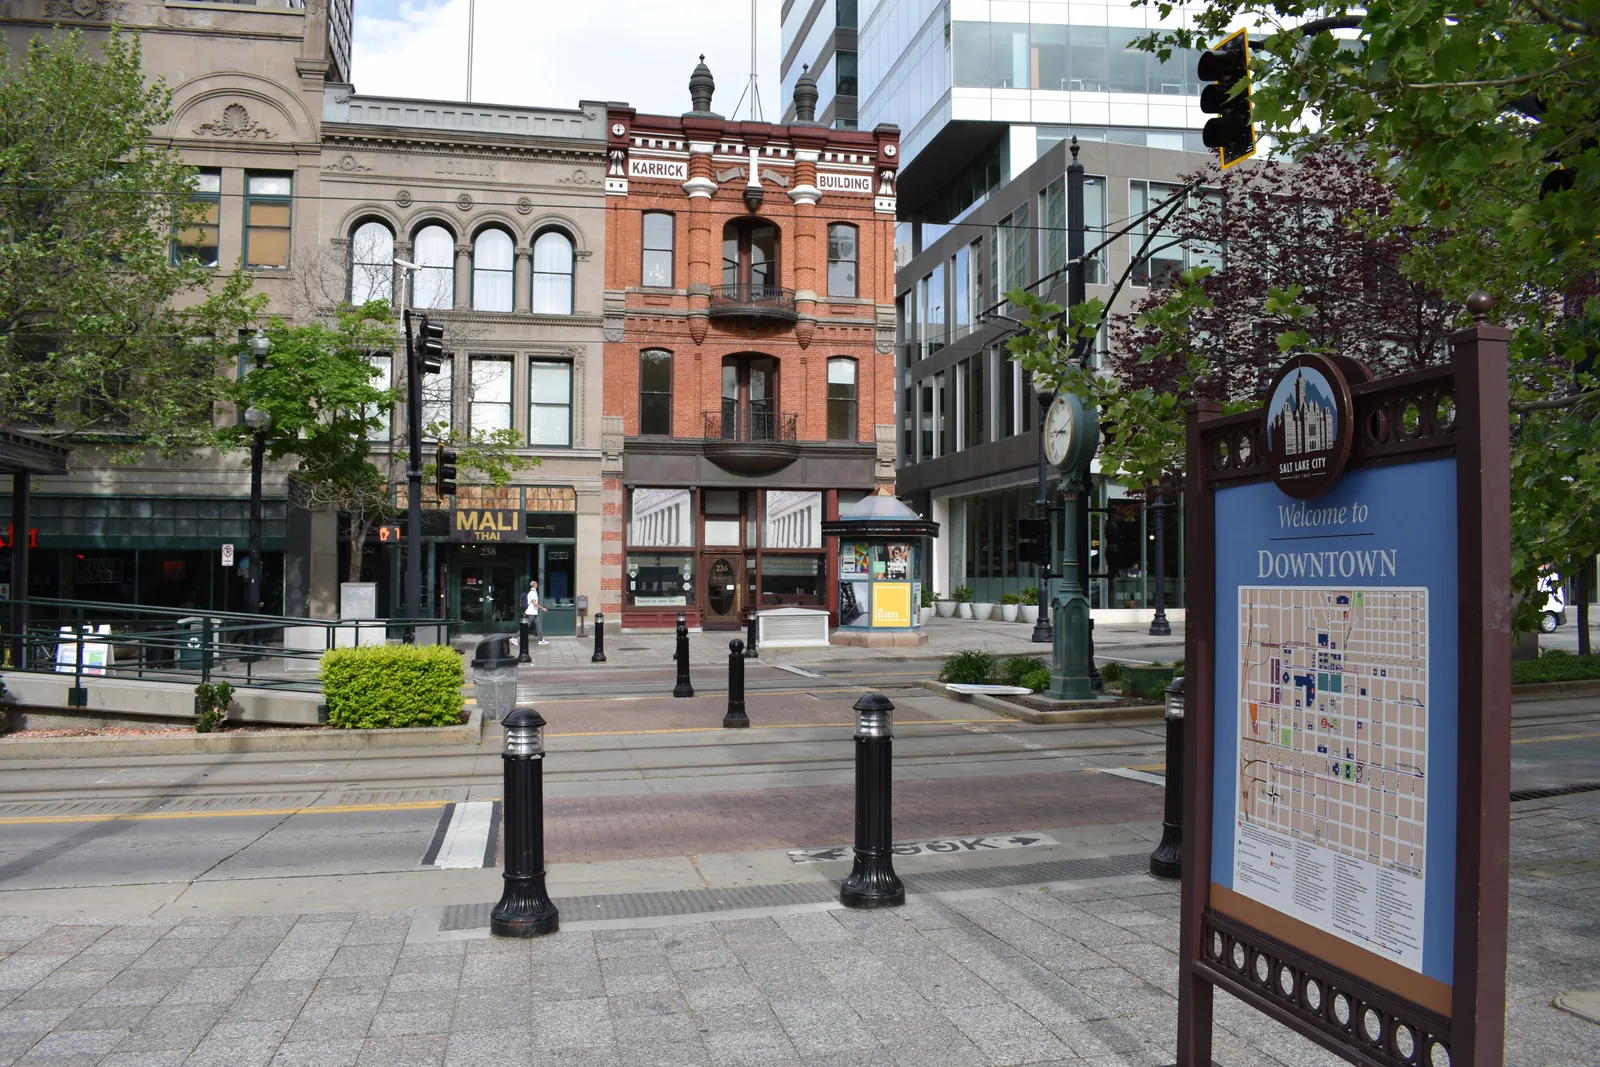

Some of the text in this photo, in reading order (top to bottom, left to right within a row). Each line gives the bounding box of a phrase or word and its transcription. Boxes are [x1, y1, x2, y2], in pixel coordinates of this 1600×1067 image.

[632, 161, 683, 177] KARRICK
[819, 175, 870, 190] BUILDING
[1279, 456, 1326, 474] SALT LAKE CITY
[456, 511, 518, 531] MALI
[1278, 501, 1369, 528] Welcome to
[474, 531, 500, 541] THAI
[480, 548, 496, 556] 238
[715, 564, 729, 572] 236
[1257, 549, 1398, 578] DOWNTOWN
[877, 611, 899, 619] BLOCKS
